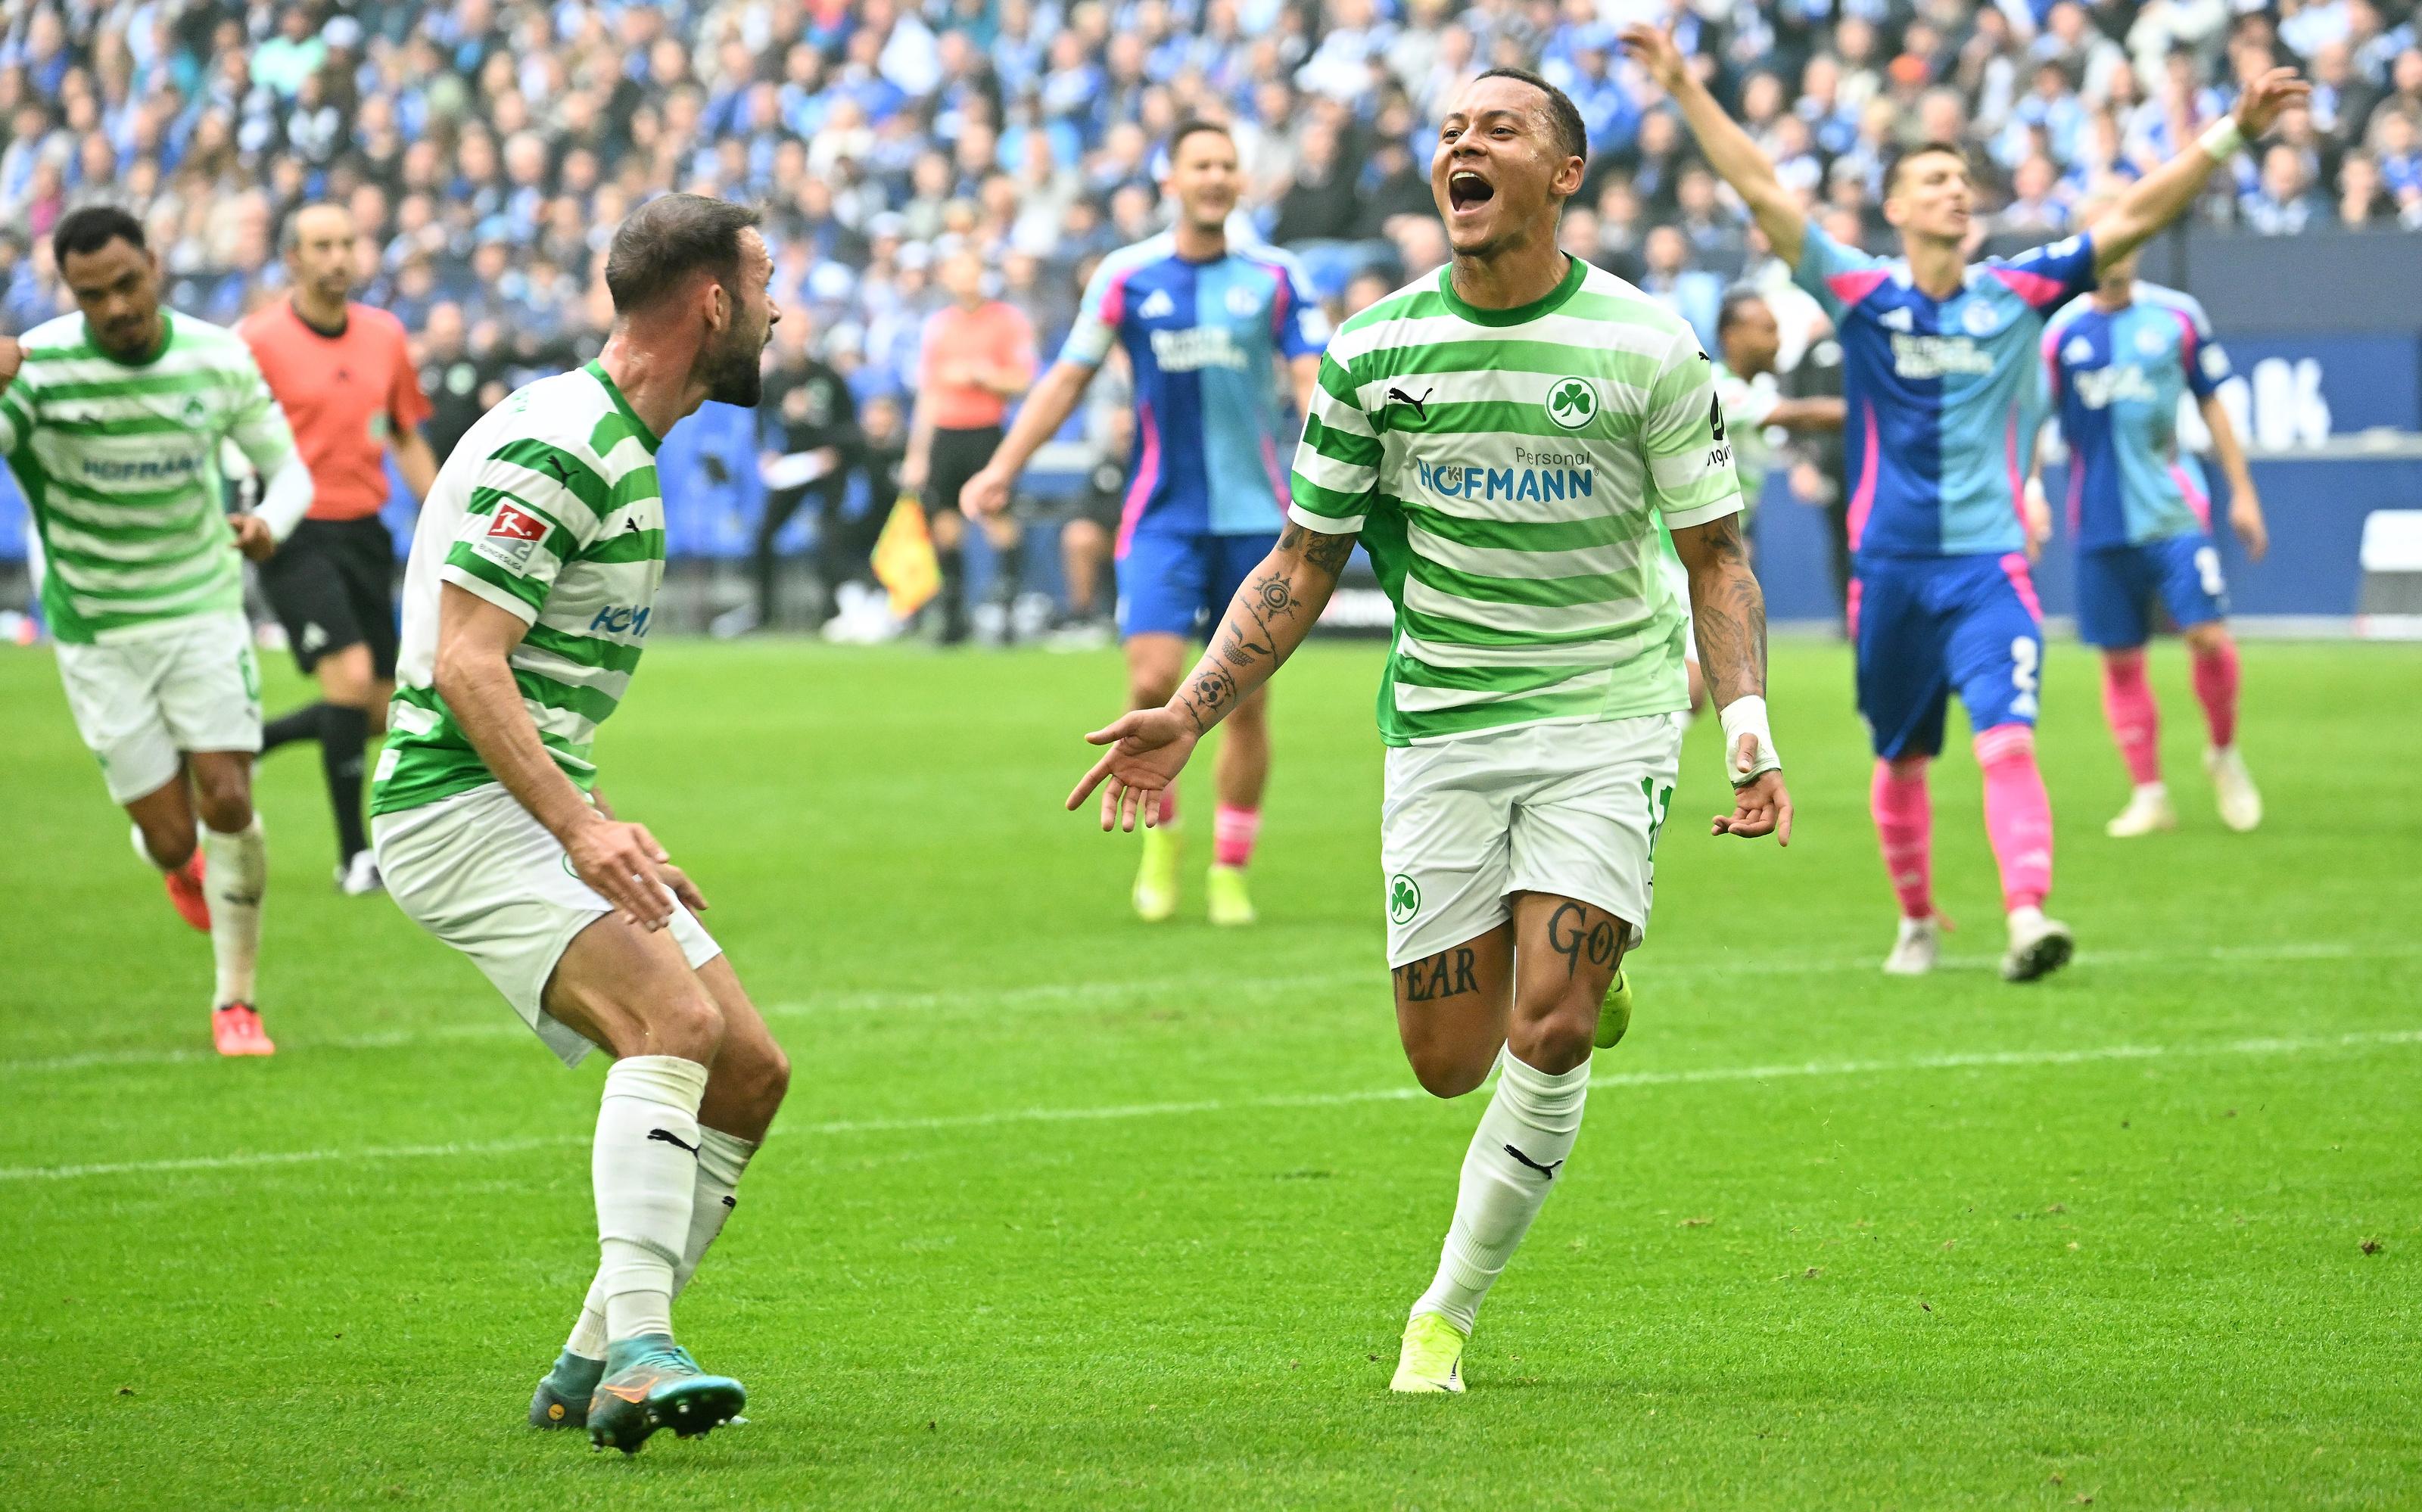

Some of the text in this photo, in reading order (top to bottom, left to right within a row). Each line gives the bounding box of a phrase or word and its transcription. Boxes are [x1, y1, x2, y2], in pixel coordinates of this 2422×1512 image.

[1515, 447, 1590, 465] Personal
[1417, 457, 1592, 502] HOFMANN
[515, 540, 534, 562] 2
[2010, 636, 2038, 691] 2
[1393, 947, 1480, 1001] EAR
